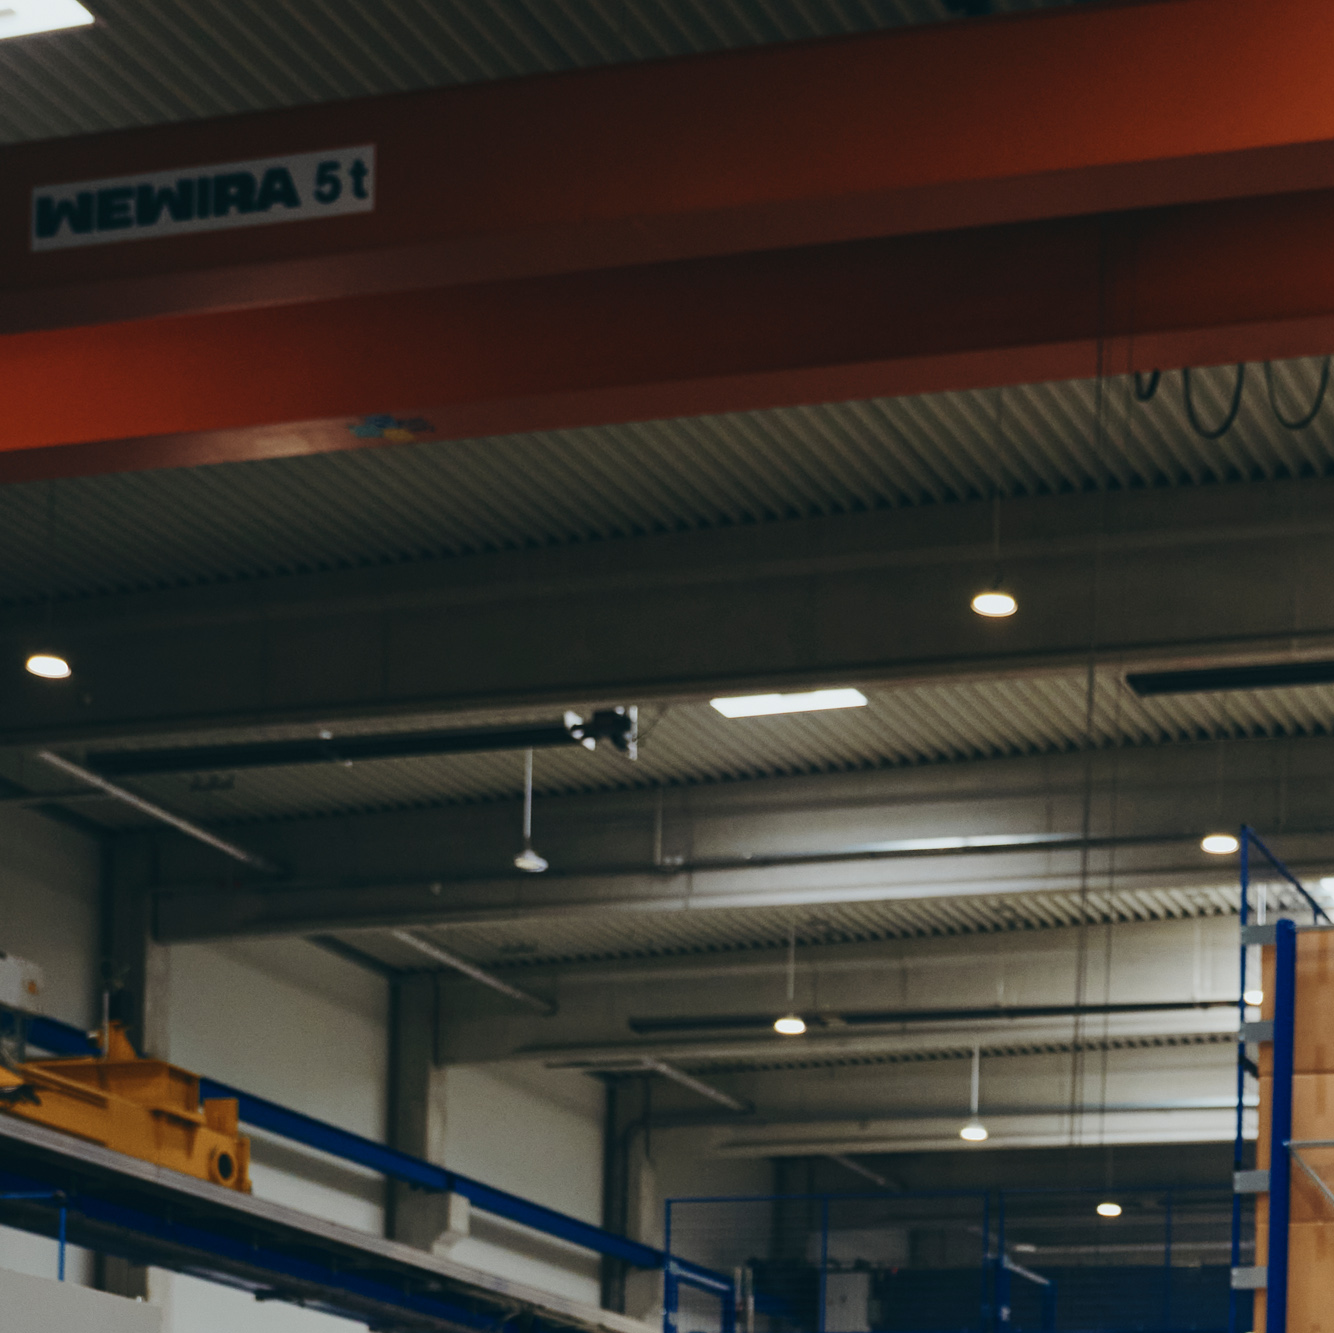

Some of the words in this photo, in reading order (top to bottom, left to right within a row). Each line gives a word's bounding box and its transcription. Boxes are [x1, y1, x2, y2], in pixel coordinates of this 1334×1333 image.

[35, 167, 300, 239] WEWIRA
[313, 160, 342, 205] 5
[349, 158, 369, 200] t
